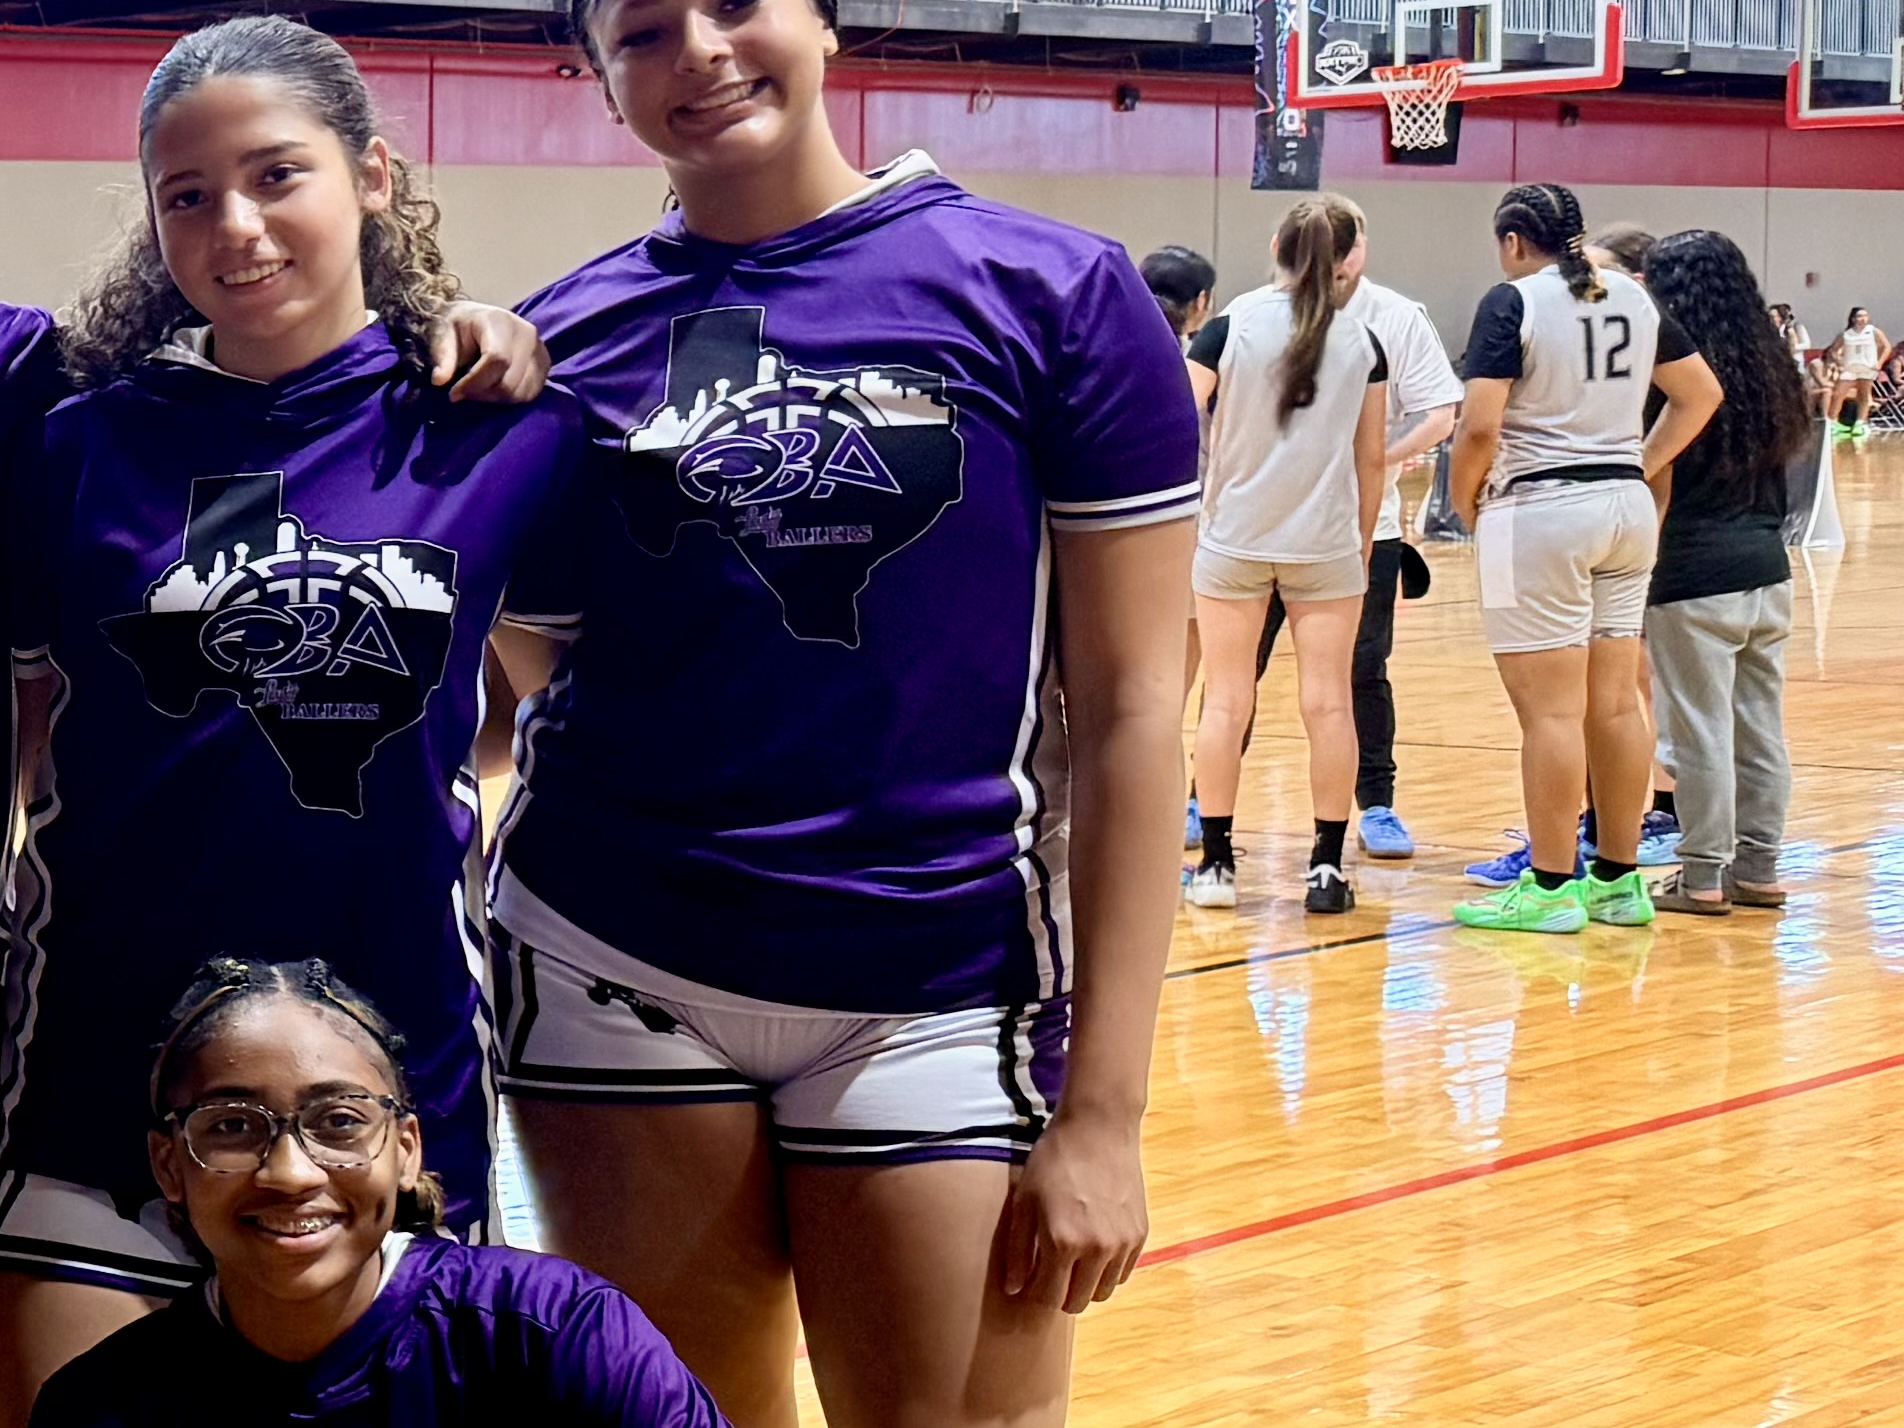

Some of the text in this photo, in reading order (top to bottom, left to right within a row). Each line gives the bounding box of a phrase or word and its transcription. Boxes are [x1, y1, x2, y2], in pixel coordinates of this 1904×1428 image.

[1577, 315, 1632, 382] 12
[766, 524, 873, 547] BALLERS
[281, 702, 380, 720] BALLERS
